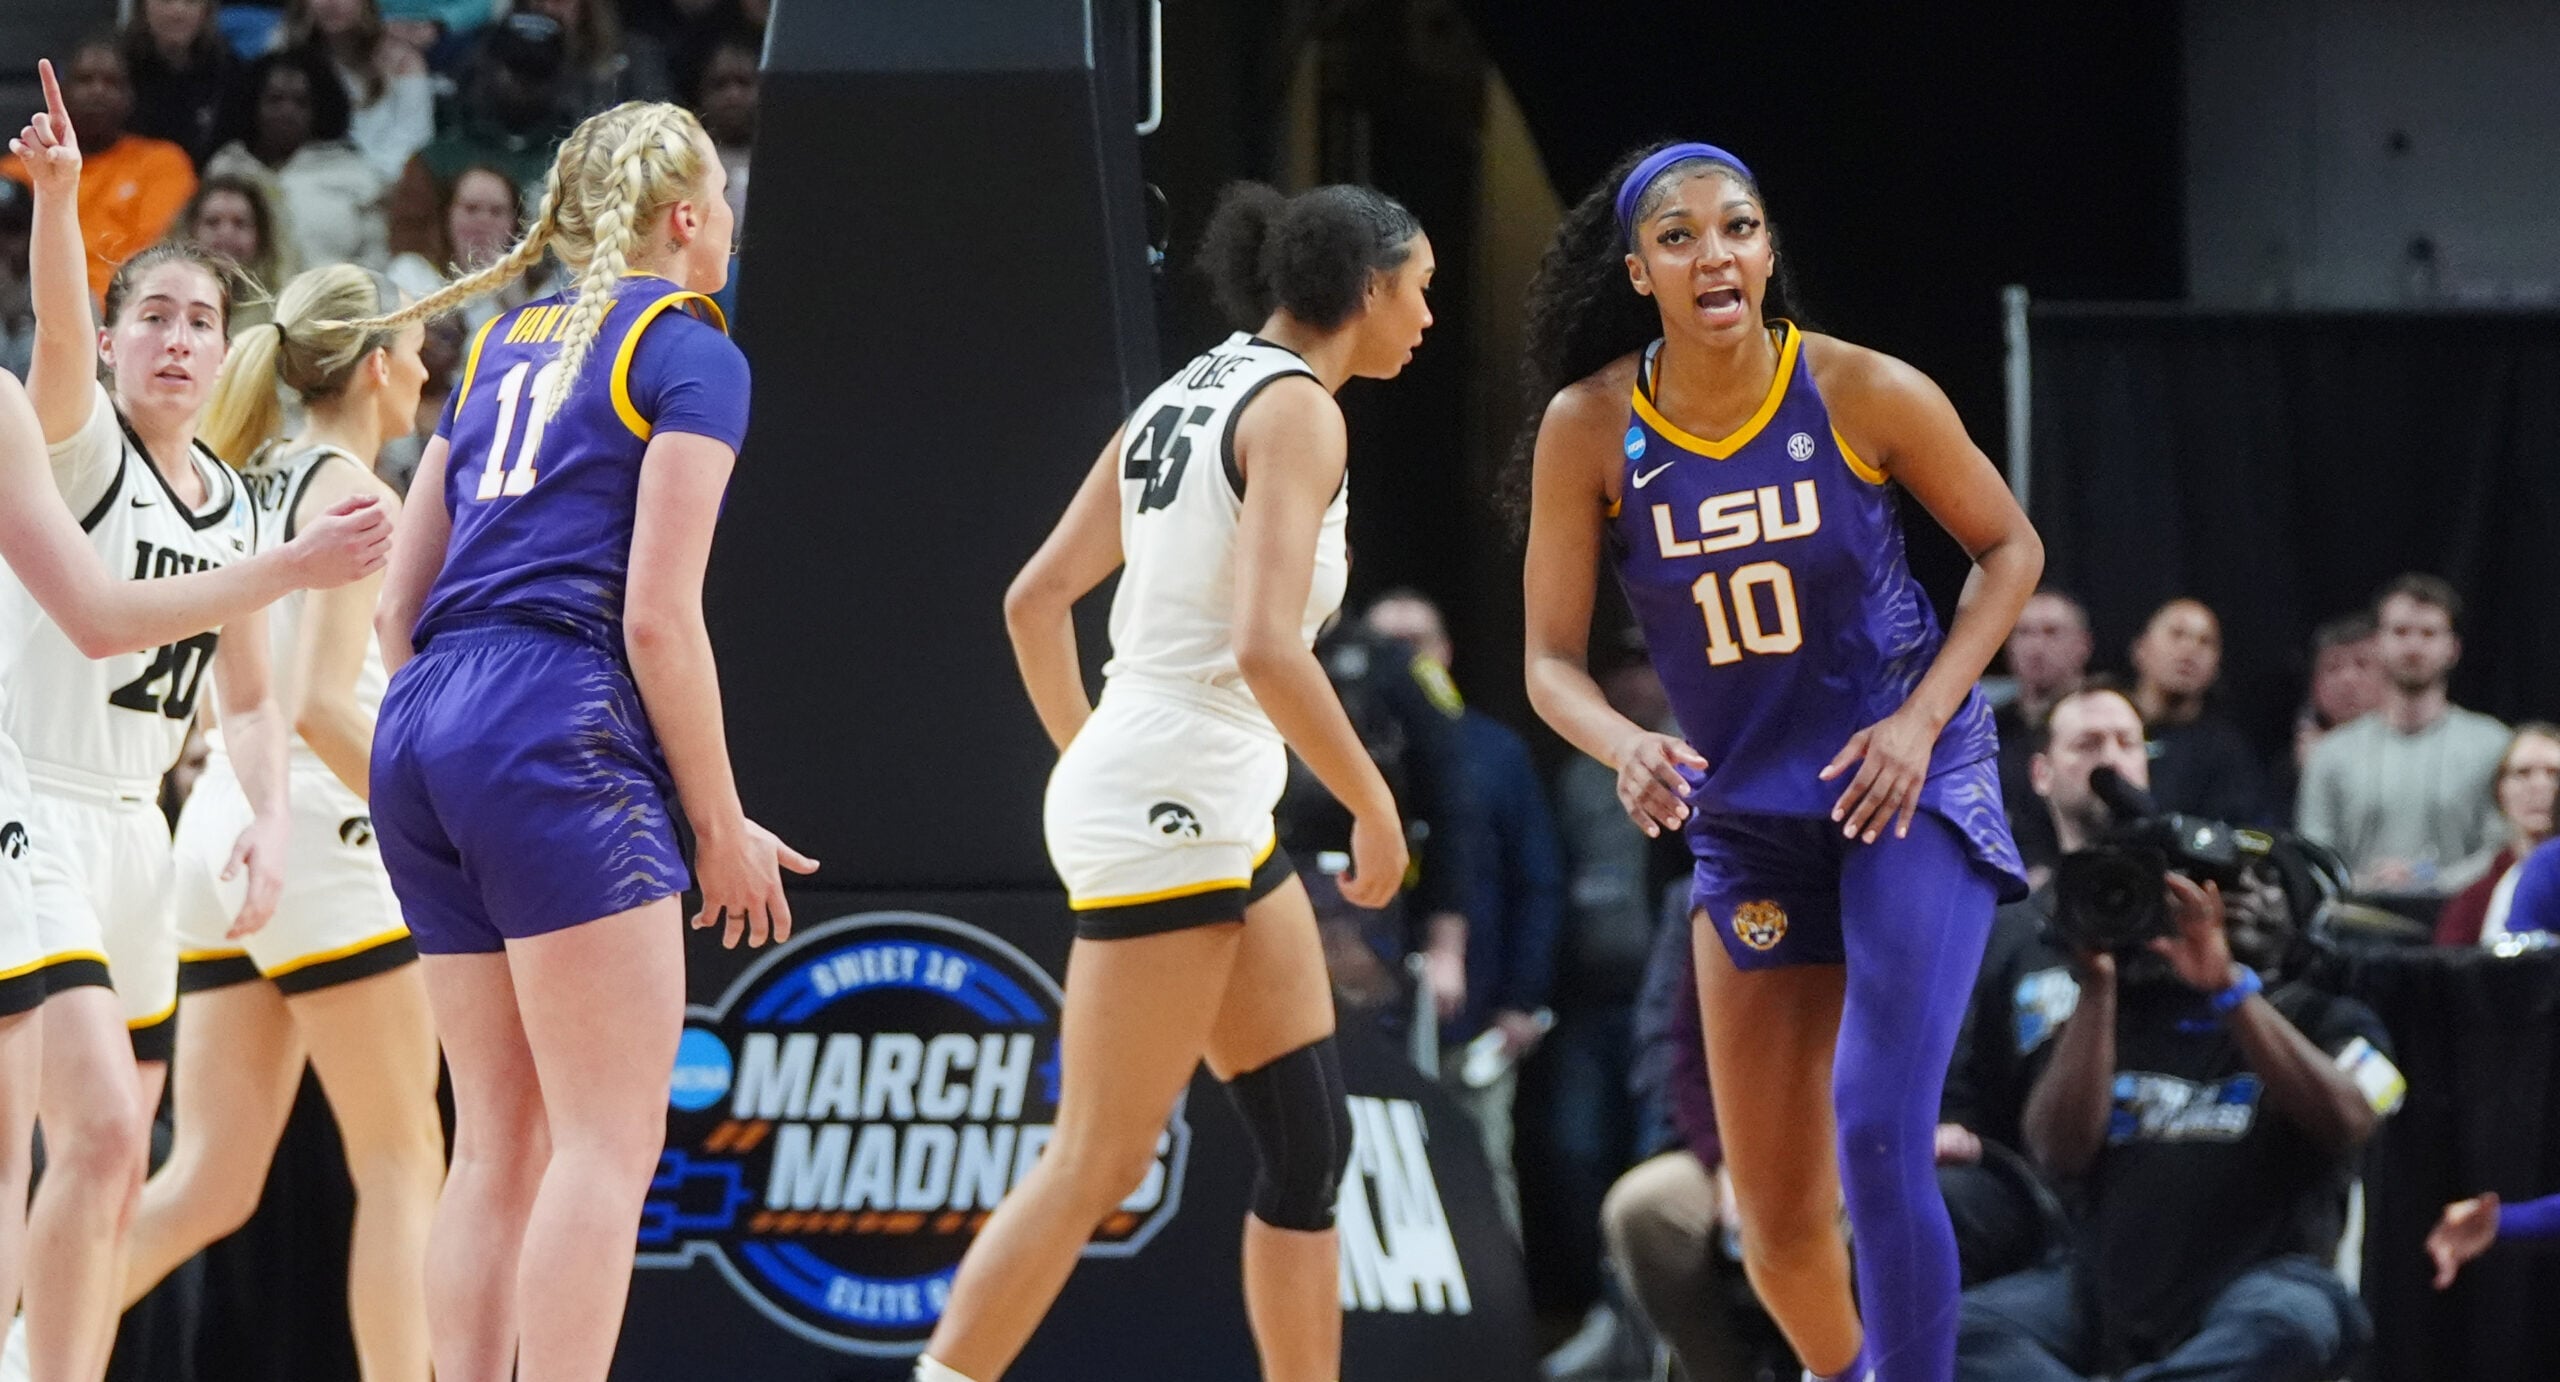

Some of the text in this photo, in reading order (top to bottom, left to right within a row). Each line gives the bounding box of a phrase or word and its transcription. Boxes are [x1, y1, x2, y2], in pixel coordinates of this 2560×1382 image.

[503, 304, 568, 344] VAN
[476, 361, 562, 500] 11
[1124, 405, 1217, 514] 45
[1789, 435, 1813, 458] SEC
[1651, 479, 1821, 559] LSU
[1691, 560, 1803, 666] 10
[108, 631, 220, 720] 20
[811, 947, 969, 997] SWEET 16
[732, 1032, 1035, 1121] MARCH
[826, 1275, 923, 1321] ELITE
